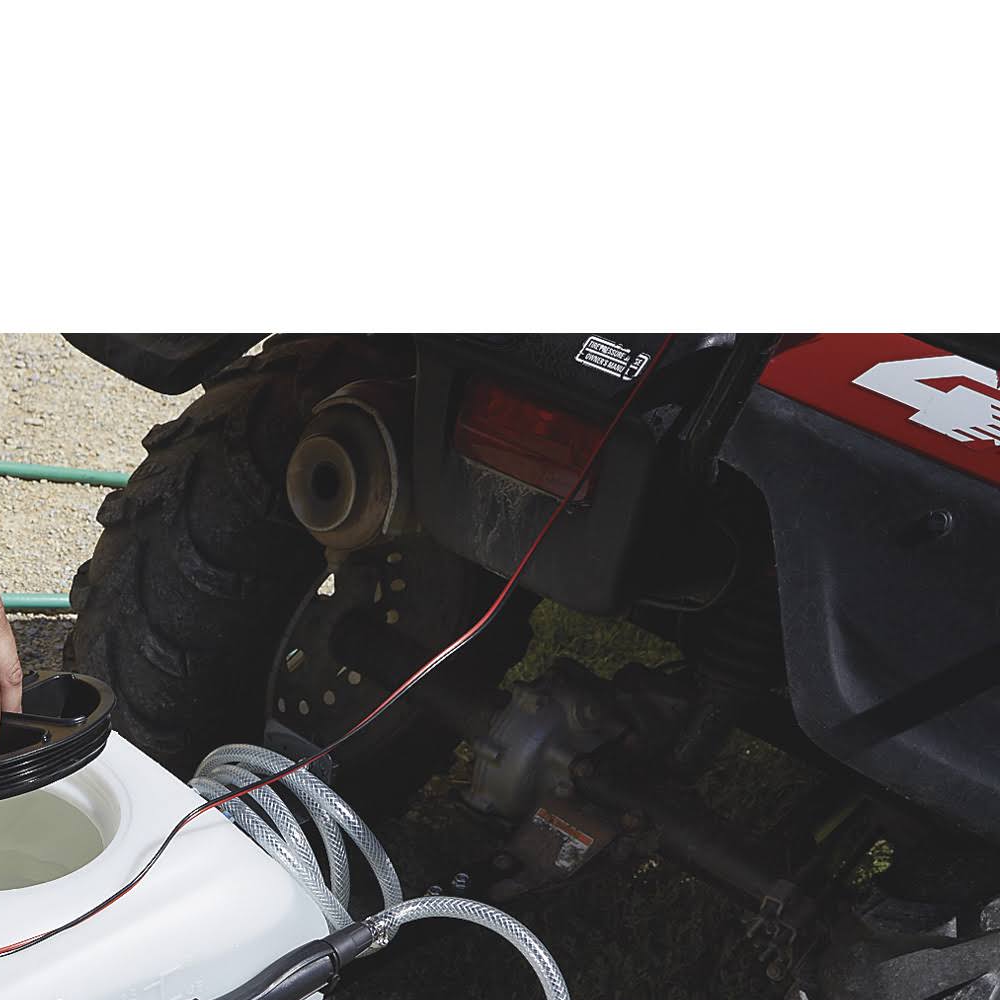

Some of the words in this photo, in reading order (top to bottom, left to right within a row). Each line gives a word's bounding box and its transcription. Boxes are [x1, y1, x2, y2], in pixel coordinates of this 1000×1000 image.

[599, 344, 626, 358] PRESSURE
[585, 353, 608, 367] OWNER'S
[608, 360, 629, 376] MANUL
